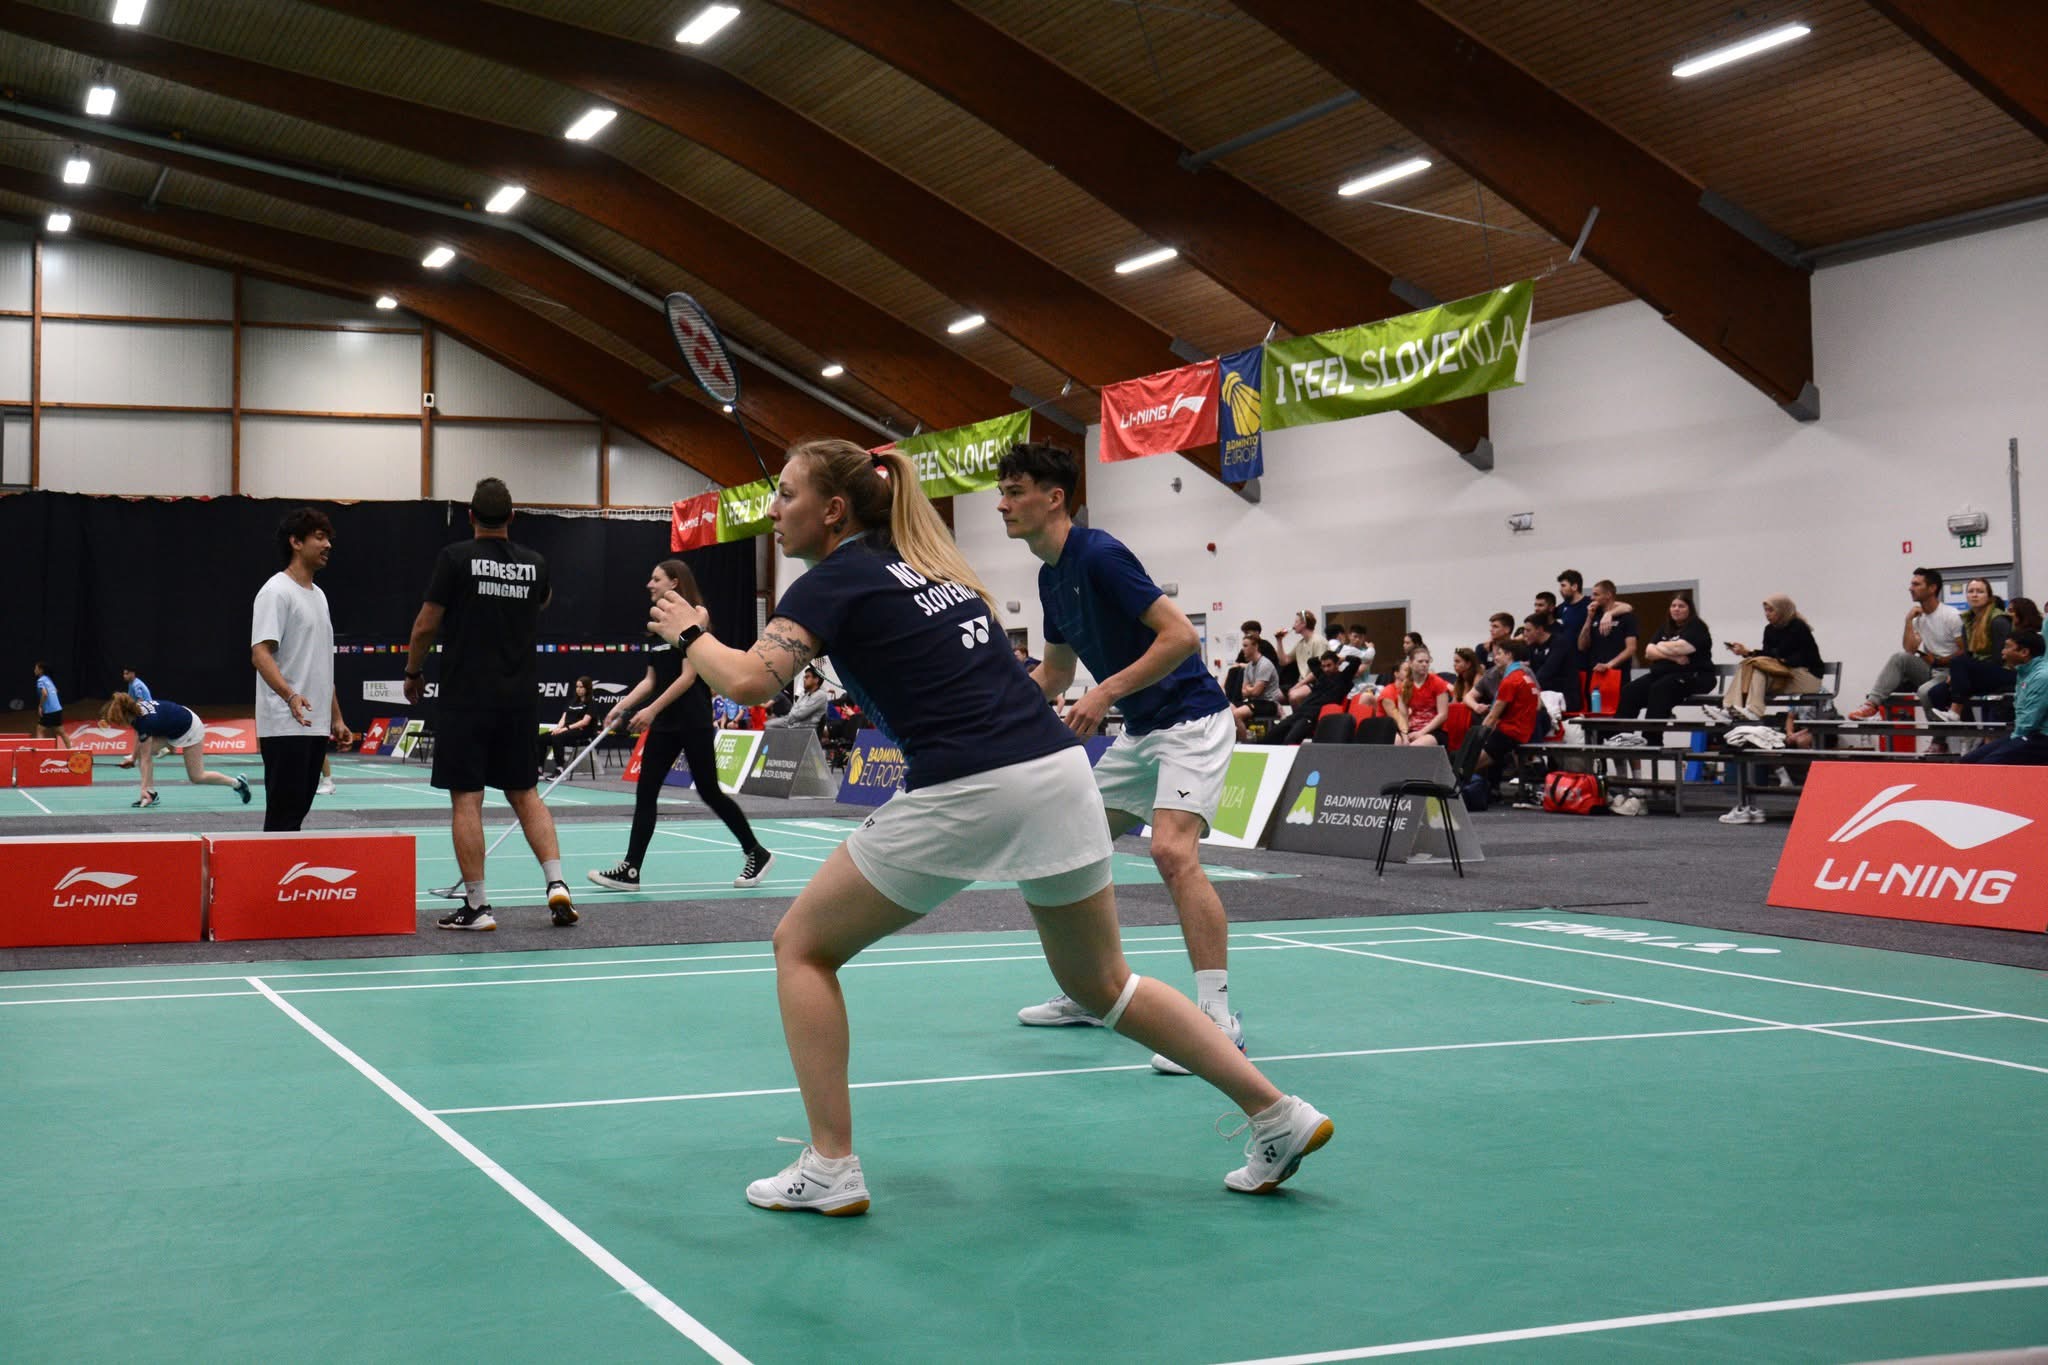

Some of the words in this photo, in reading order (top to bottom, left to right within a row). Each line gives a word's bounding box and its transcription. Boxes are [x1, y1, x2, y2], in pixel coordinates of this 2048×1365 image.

[1276, 366, 1287, 405] I
[1290, 355, 1355, 402] FEEL
[1360, 315, 1519, 391] SLOVENIA
[1119, 404, 1168, 430] LI-NING
[471, 558, 537, 582] KERESZTI
[885, 561, 927, 588] NO
[478, 580, 530, 599] HUNGARY
[204, 739, 247, 749] -NING
[1317, 812, 1351, 825] ZVEZA
[1352, 815, 1408, 831] SLOVEIJE
[1814, 858, 2018, 905] LI-NING
[53, 892, 138, 908] LI-NING
[278, 887, 358, 902] LI-NING
